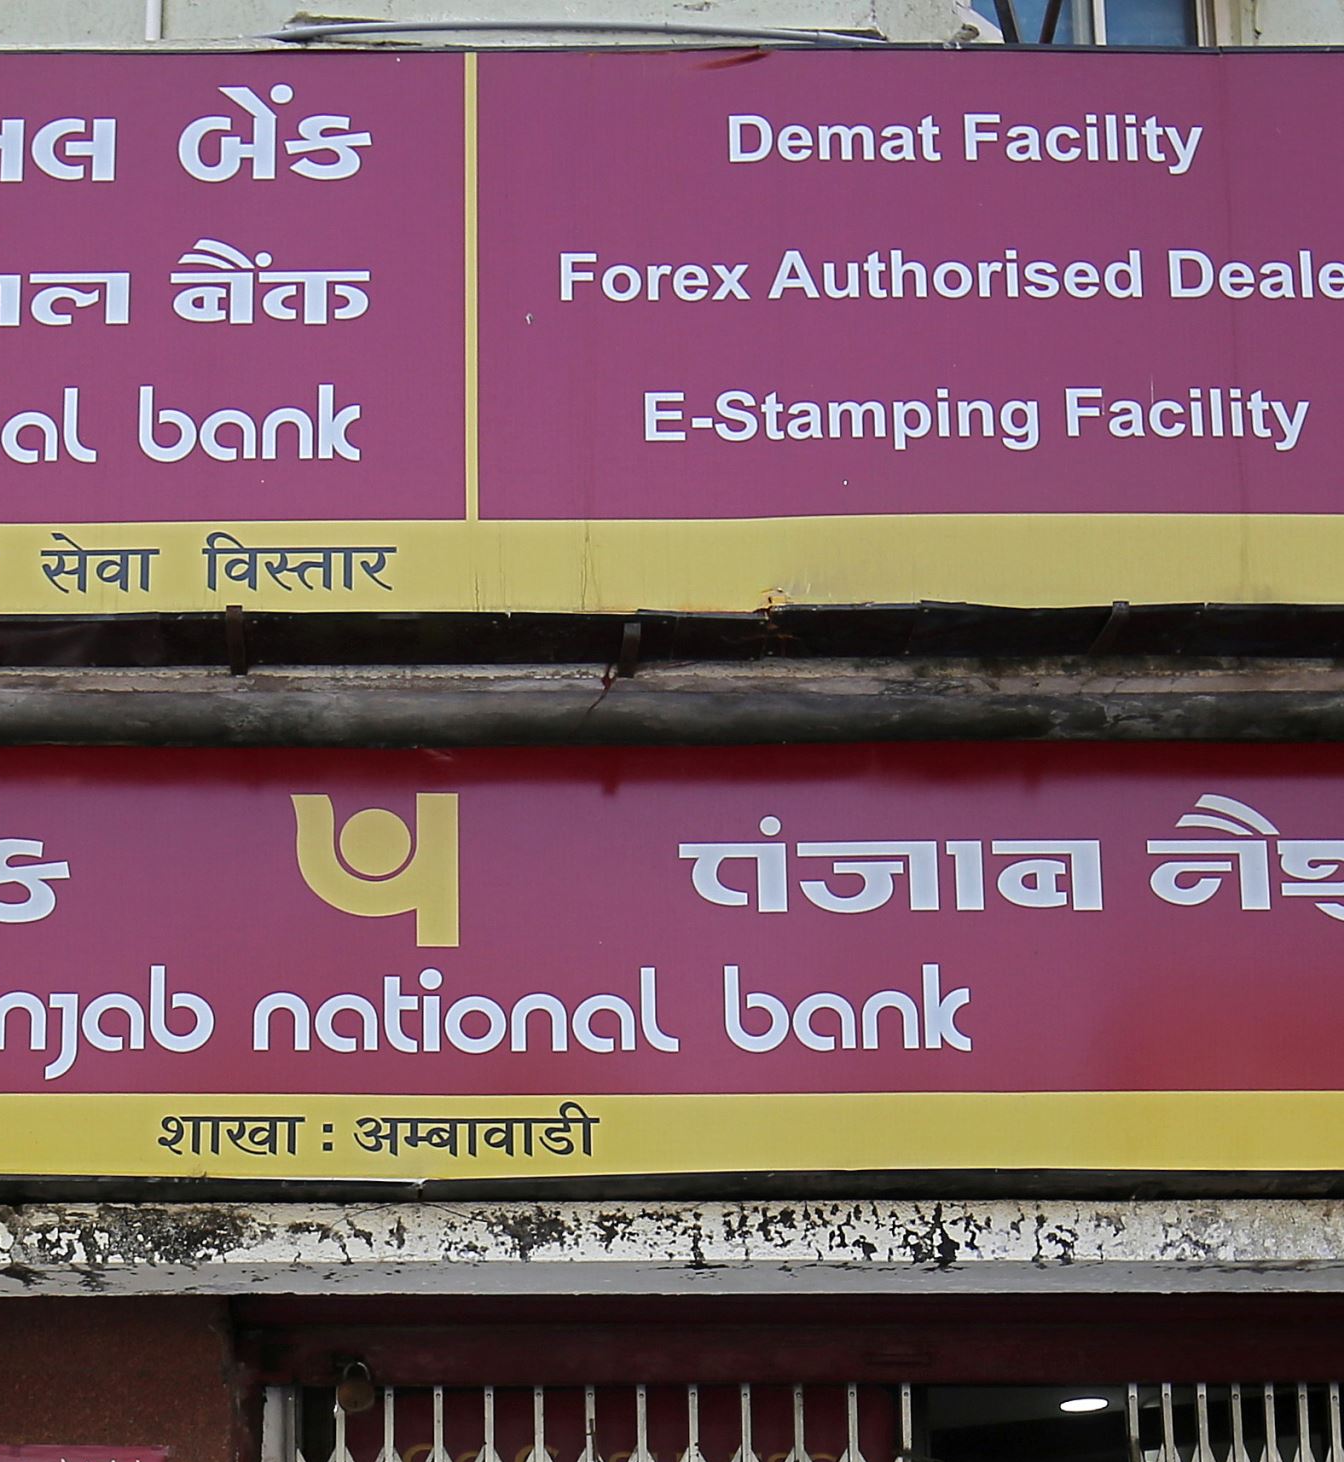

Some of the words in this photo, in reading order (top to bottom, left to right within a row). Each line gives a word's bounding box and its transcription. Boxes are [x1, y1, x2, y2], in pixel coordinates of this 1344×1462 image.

[178, 84, 371, 182] બેંક
[728, 113, 940, 164] Demat
[962, 112, 1203, 175] Facility
[171, 238, 370, 327] बैंक
[558, 251, 751, 301] Forex
[769, 248, 1144, 300] Authorised
[138, 383, 361, 463] bank
[643, 387, 1040, 451] E-Stamping
[1065, 387, 1309, 451] Facility
[41, 533, 160, 593] सेवा
[202, 532, 397, 591] विस्तार
[678, 815, 1104, 914] पंजाब
[252, 968, 680, 1054] national
[723, 962, 972, 1054] bank
[157, 1113, 305, 1157] शाखा
[352, 1102, 600, 1157] अम्बावाडी
